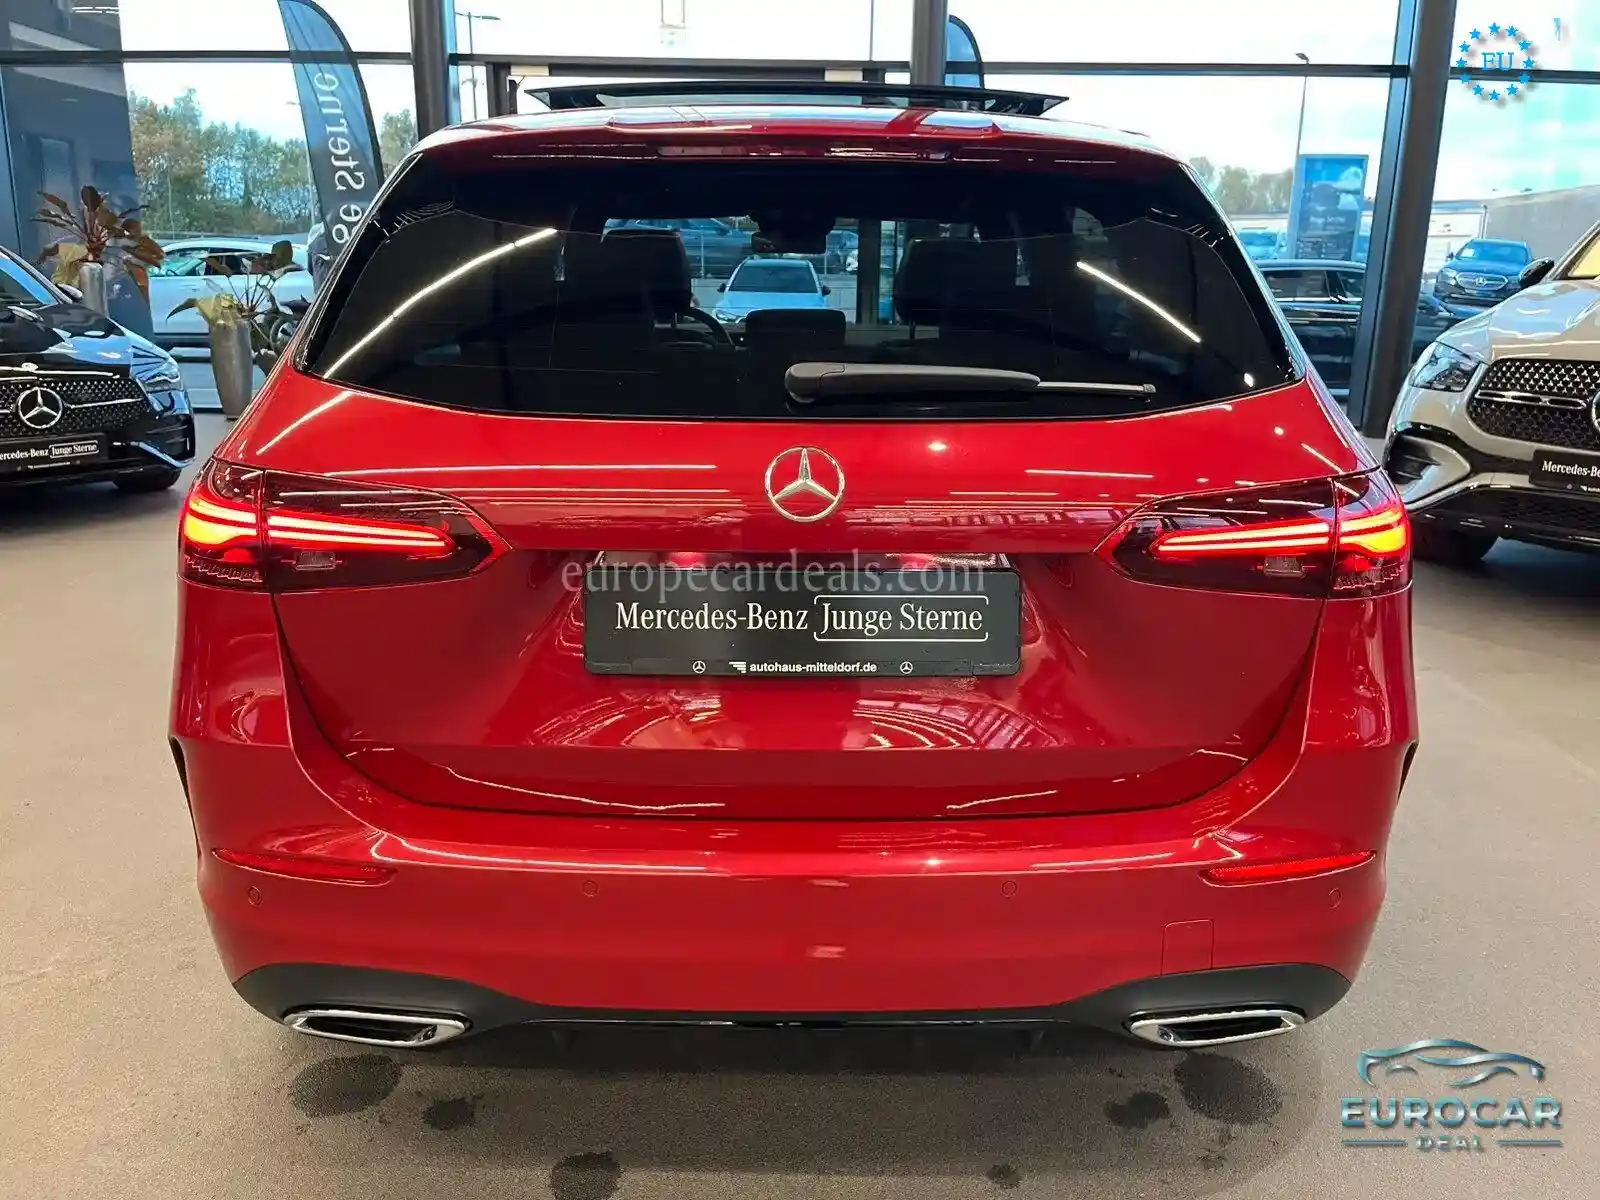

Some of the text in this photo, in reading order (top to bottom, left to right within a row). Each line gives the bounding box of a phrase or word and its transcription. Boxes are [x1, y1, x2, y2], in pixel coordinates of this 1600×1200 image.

[0, 448, 49, 460] ercedes-Benz
[1541, 460, 1600, 478] Mercedes-Be
[615, 602, 983, 636] Mercedes-Benz Junge Sterne
[749, 661, 877, 674] autohaus-mitteldorf.de
